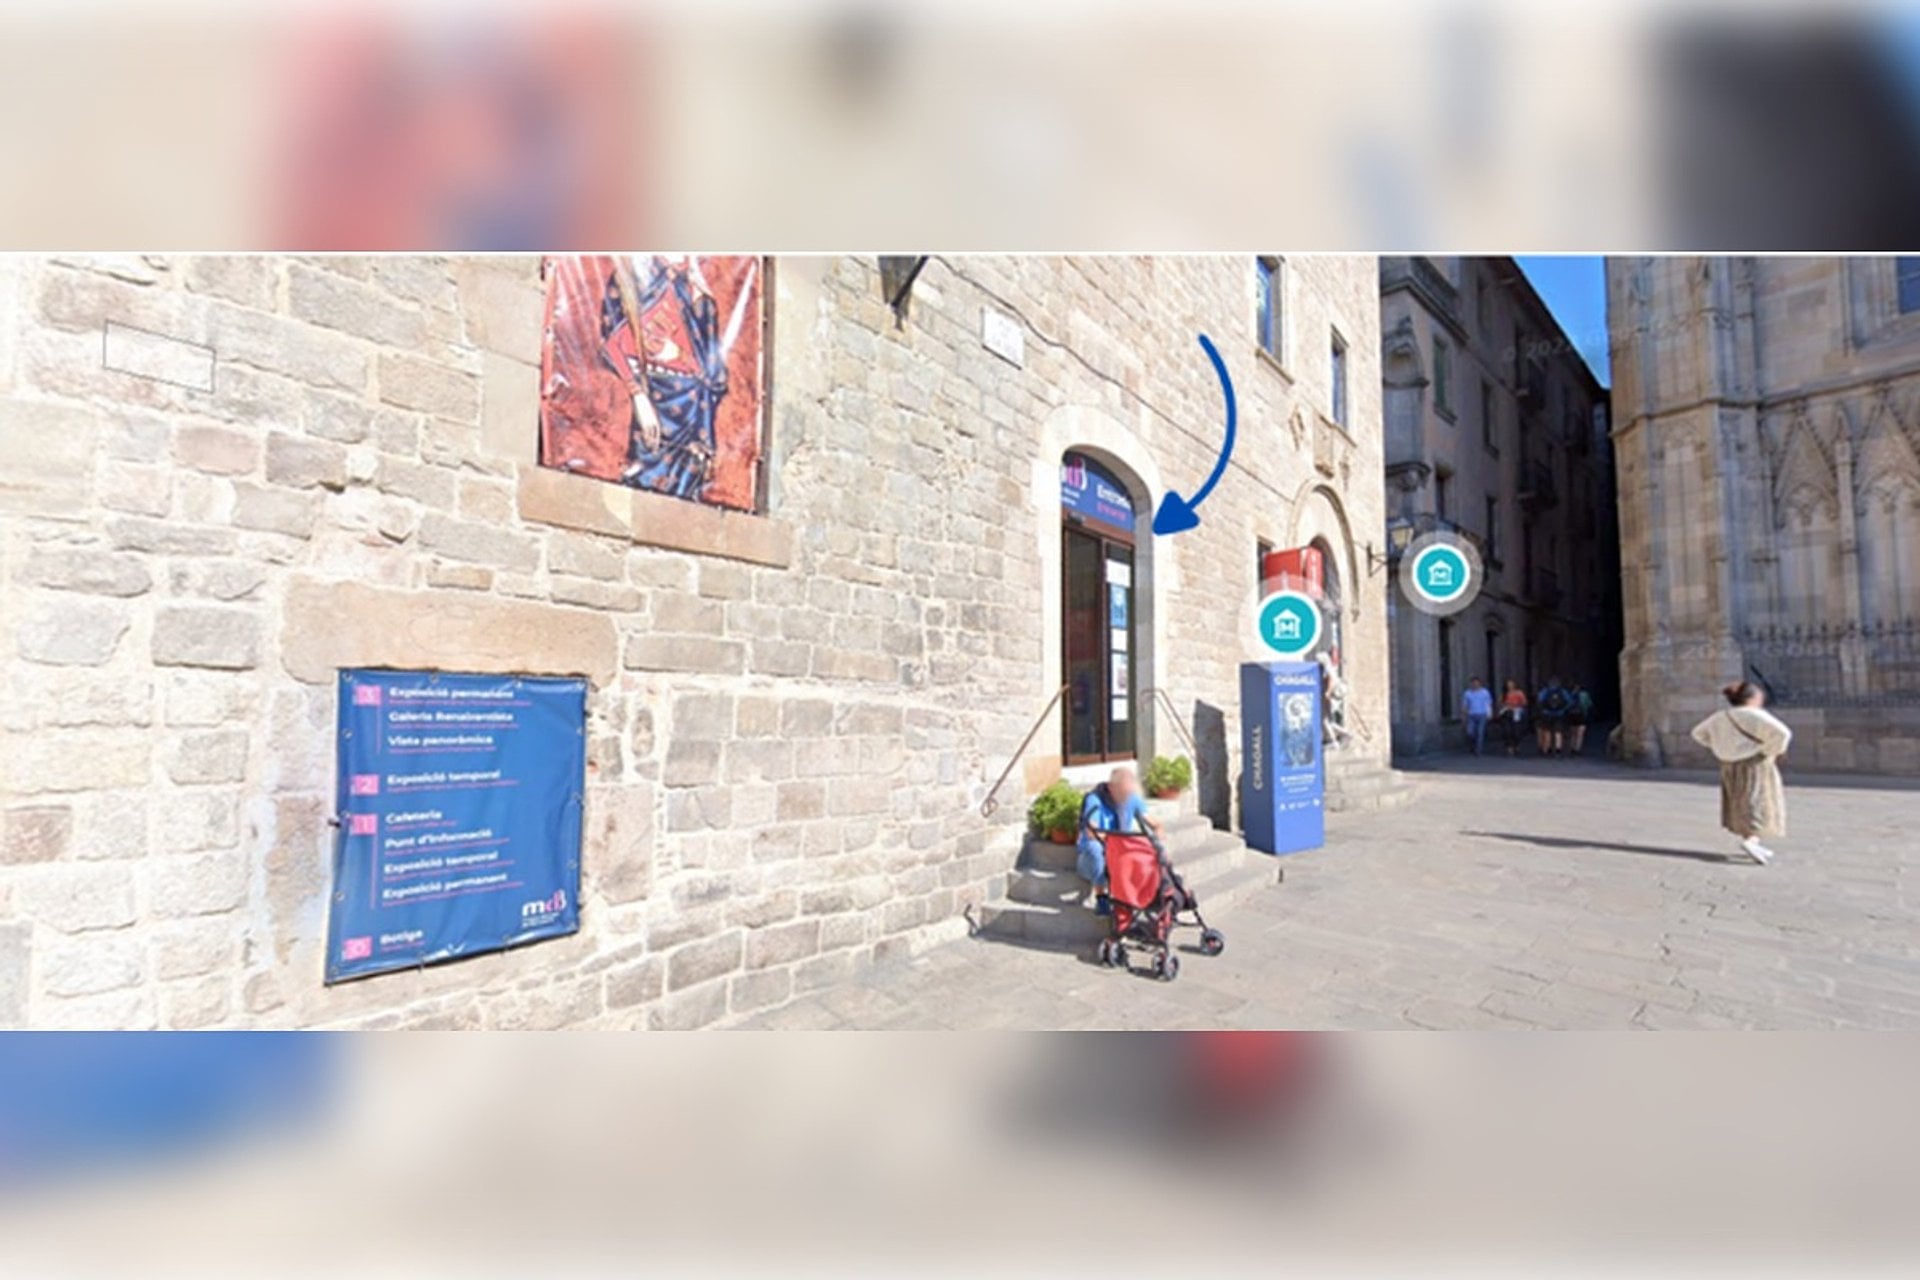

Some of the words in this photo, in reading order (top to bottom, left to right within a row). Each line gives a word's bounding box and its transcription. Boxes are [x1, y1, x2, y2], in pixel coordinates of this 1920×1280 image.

[388, 687, 449, 698] Exposició
[387, 735, 420, 746] Vista
[1252, 725, 1264, 791] CHAGALL
[387, 772, 445, 785] Exposició
[449, 771, 500, 782] temporal
[386, 811, 442, 823] Cafeteria
[384, 837, 416, 849] Punt
[384, 858, 442, 875] Exposició
[446, 851, 498, 866] temporal
[382, 882, 442, 900] Exposició
[444, 873, 507, 890] permanent
[380, 930, 423, 944] Botiga
